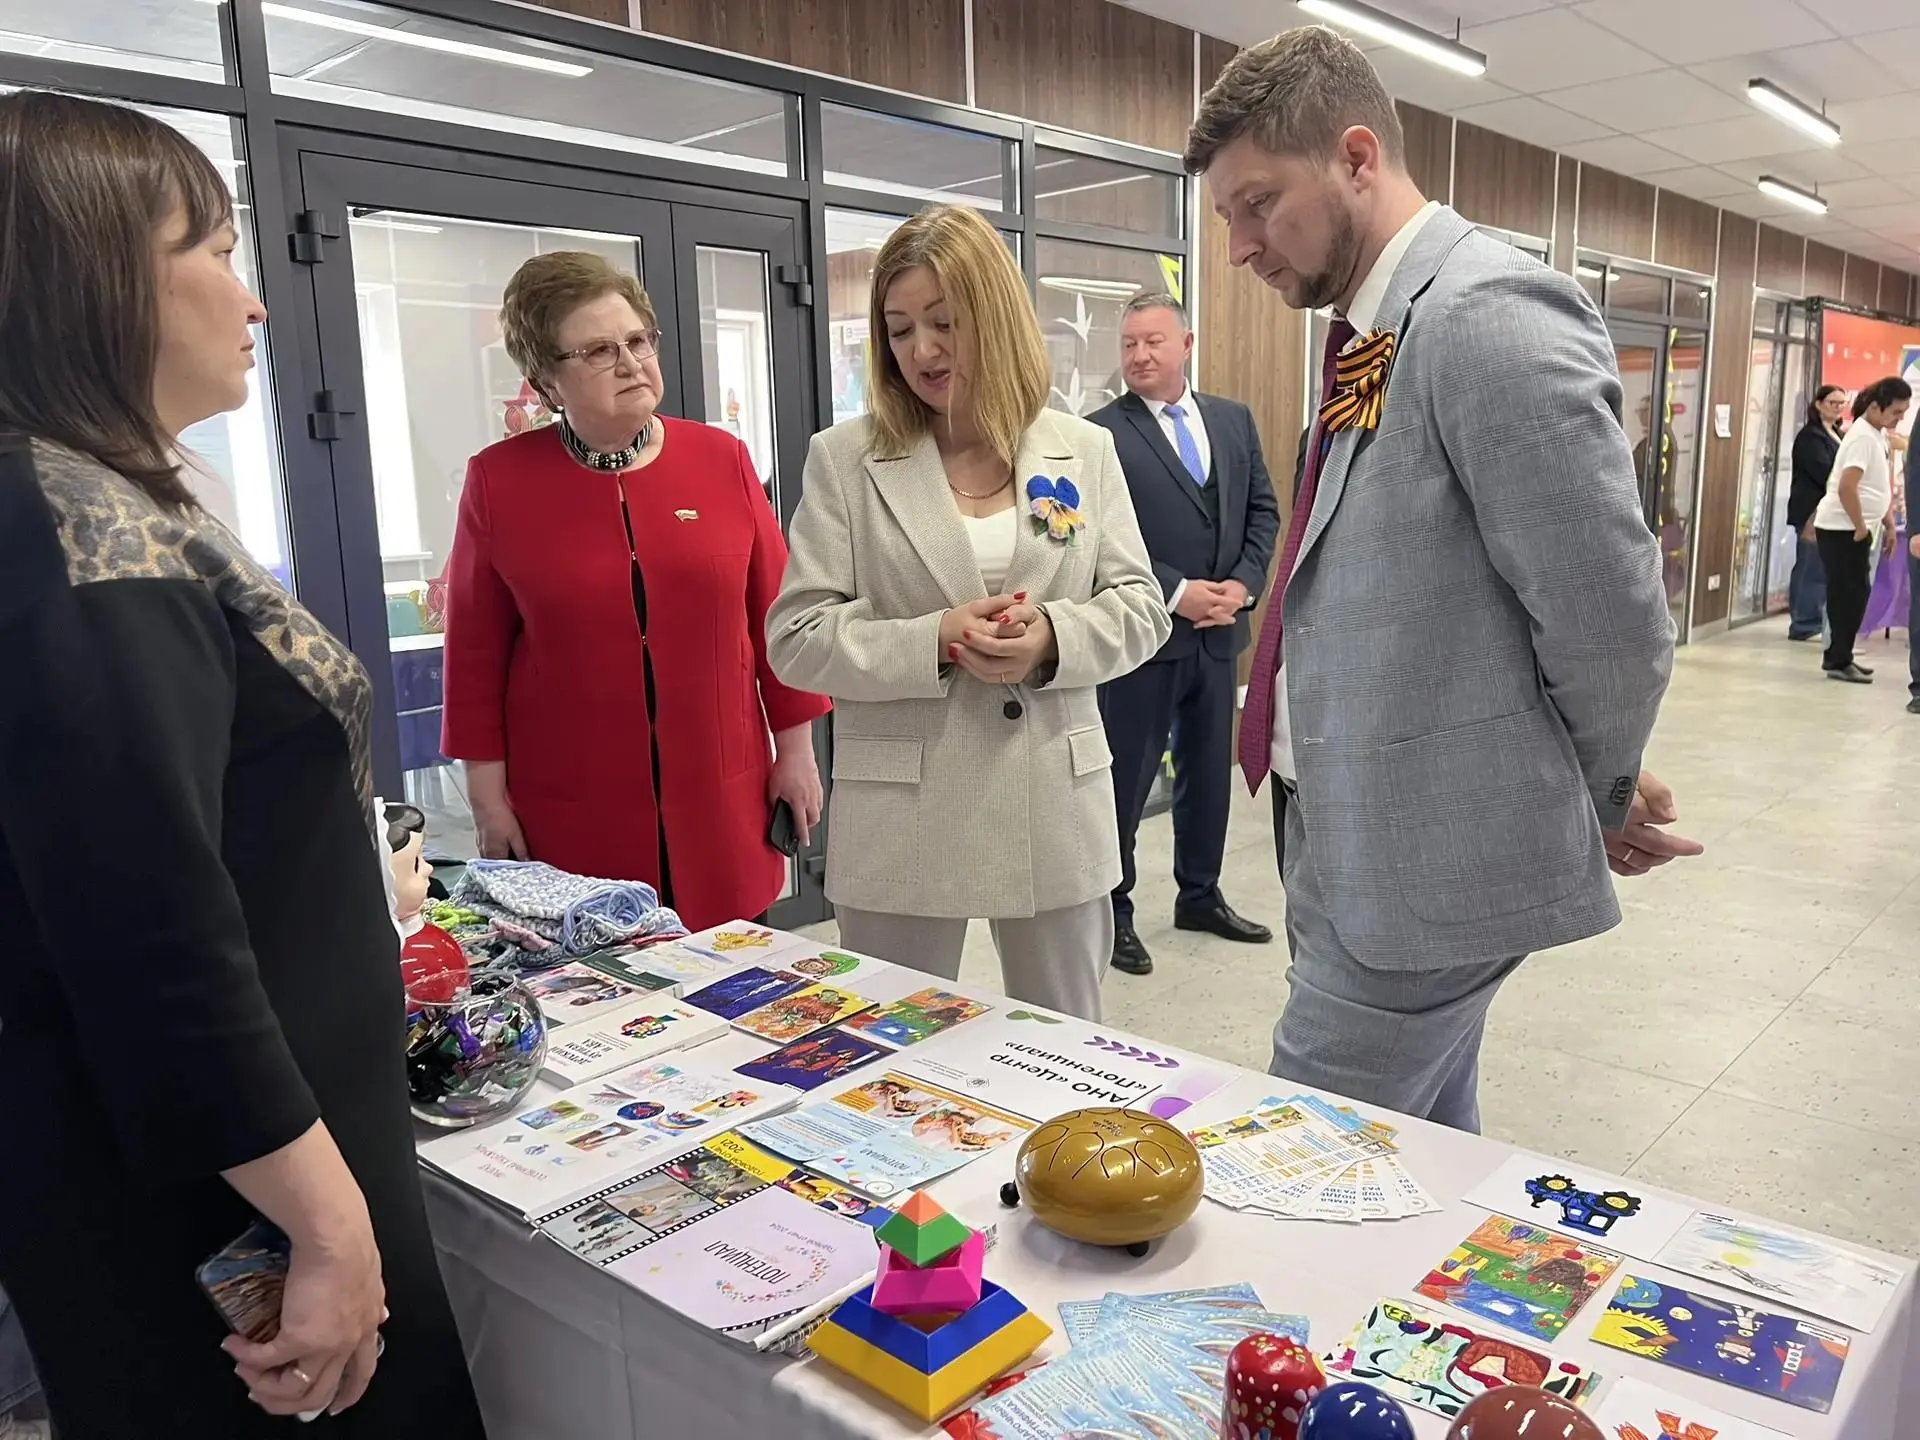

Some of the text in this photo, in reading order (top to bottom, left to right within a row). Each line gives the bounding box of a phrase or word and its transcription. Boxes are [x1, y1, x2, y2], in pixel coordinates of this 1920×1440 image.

[989, 1054, 1068, 1082] «Центр
[1005, 1041, 1147, 1090] «Потенциал»
[1071, 1082, 1129, 1103] АНО
[703, 1240, 791, 1285] ПОТЕНЦИАЛ
[990, 1402, 1038, 1440] ДАРОЧНЫЙ
